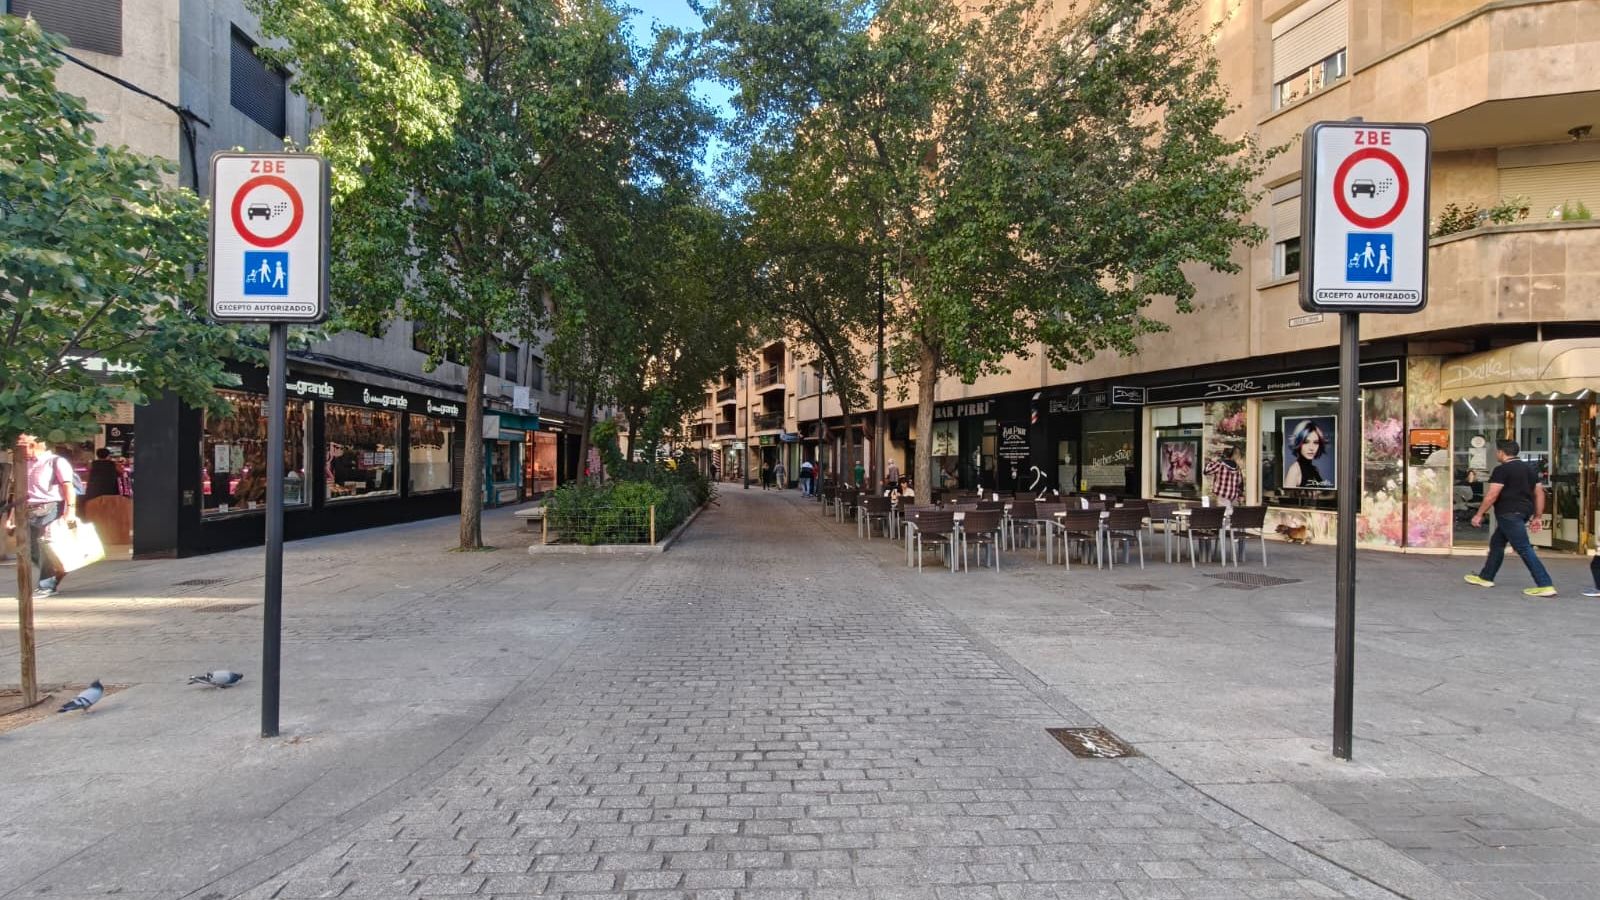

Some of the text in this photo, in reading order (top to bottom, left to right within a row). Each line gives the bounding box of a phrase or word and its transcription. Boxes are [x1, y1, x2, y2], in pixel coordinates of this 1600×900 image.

[1354, 131, 1391, 145] ZBE
[250, 160, 286, 173] ZBE
[1318, 292, 1417, 300] EXCEPTO AUTORIZADOS
[254, 304, 312, 312] AUTORIZADOS
[297, 380, 334, 396] grande
[1204, 379, 1262, 396] Dania
[957, 402, 989, 416] PIRRI
